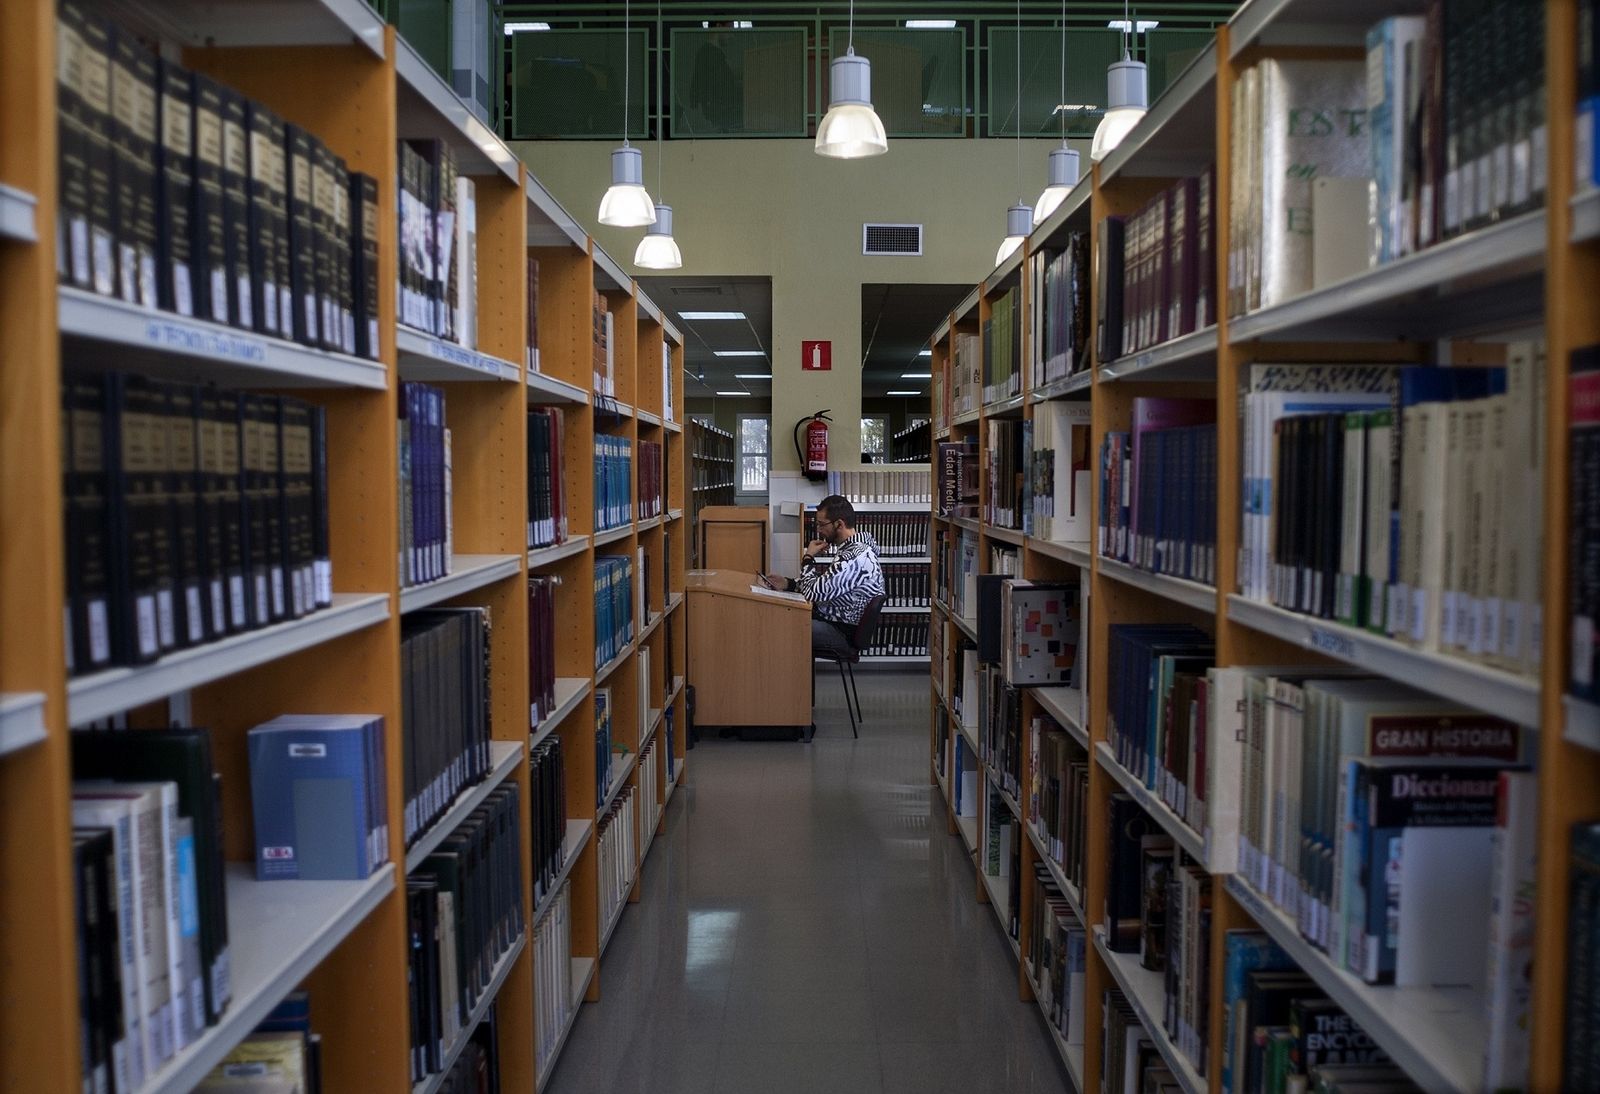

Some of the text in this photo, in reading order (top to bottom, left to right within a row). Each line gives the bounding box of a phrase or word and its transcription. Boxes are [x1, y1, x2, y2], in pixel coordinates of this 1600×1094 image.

[1288, 109, 1367, 136] EST
[945, 449, 956, 512] Edad Media
[1376, 728, 1512, 748] GRAN HISTORIA
[1391, 773, 1498, 798] Diccionar
[1315, 1015, 1349, 1032] THE
